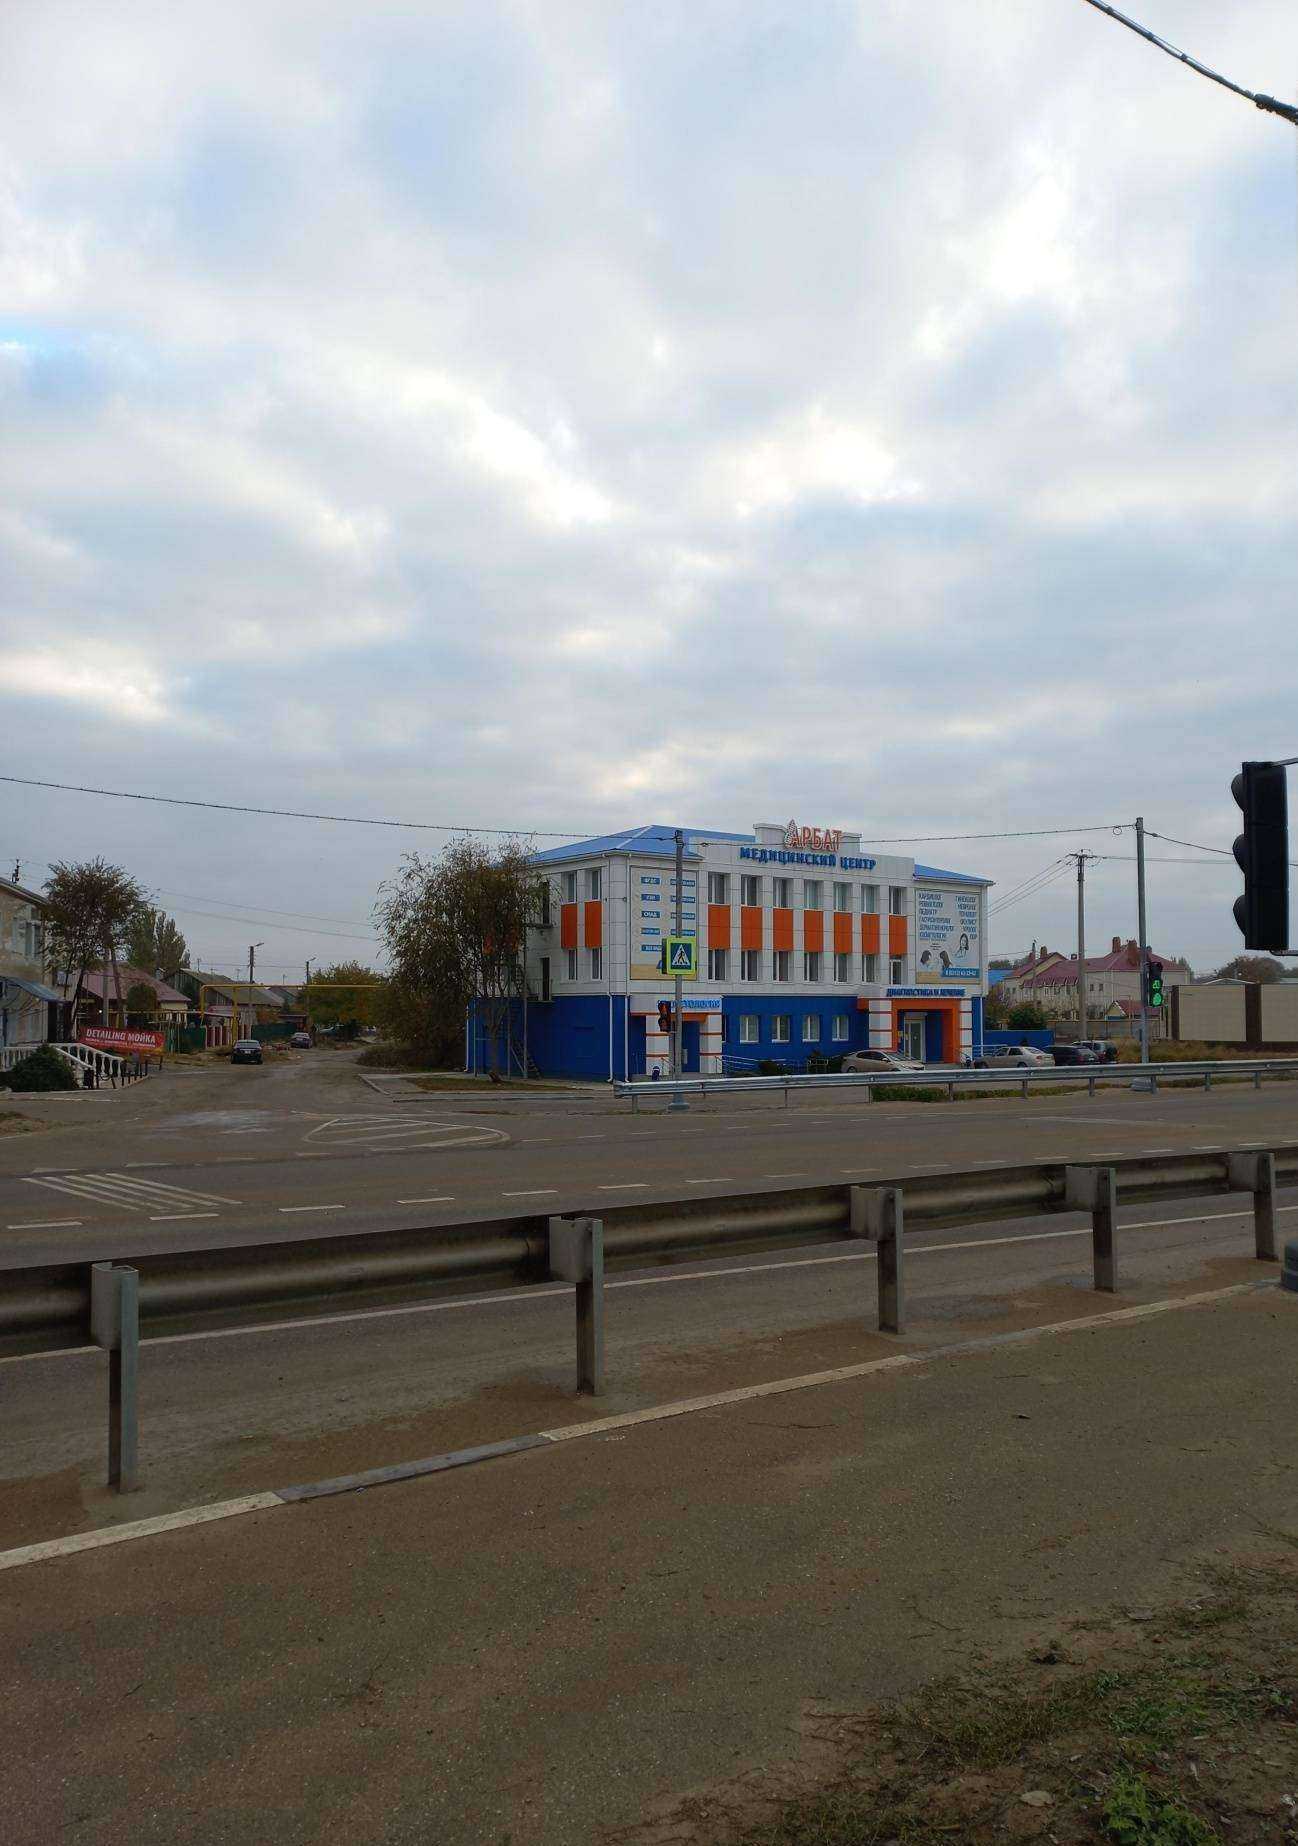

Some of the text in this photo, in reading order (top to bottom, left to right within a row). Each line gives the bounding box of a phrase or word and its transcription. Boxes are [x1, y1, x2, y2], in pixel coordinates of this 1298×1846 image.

[785, 819, 843, 851] АРБАТ
[740, 847, 877, 871] МЕДИЦИНСКИЙ ЦЕНТР
[87, 1029, 126, 1041] DETAILING
[128, 1033, 156, 1044] МОЙКА
